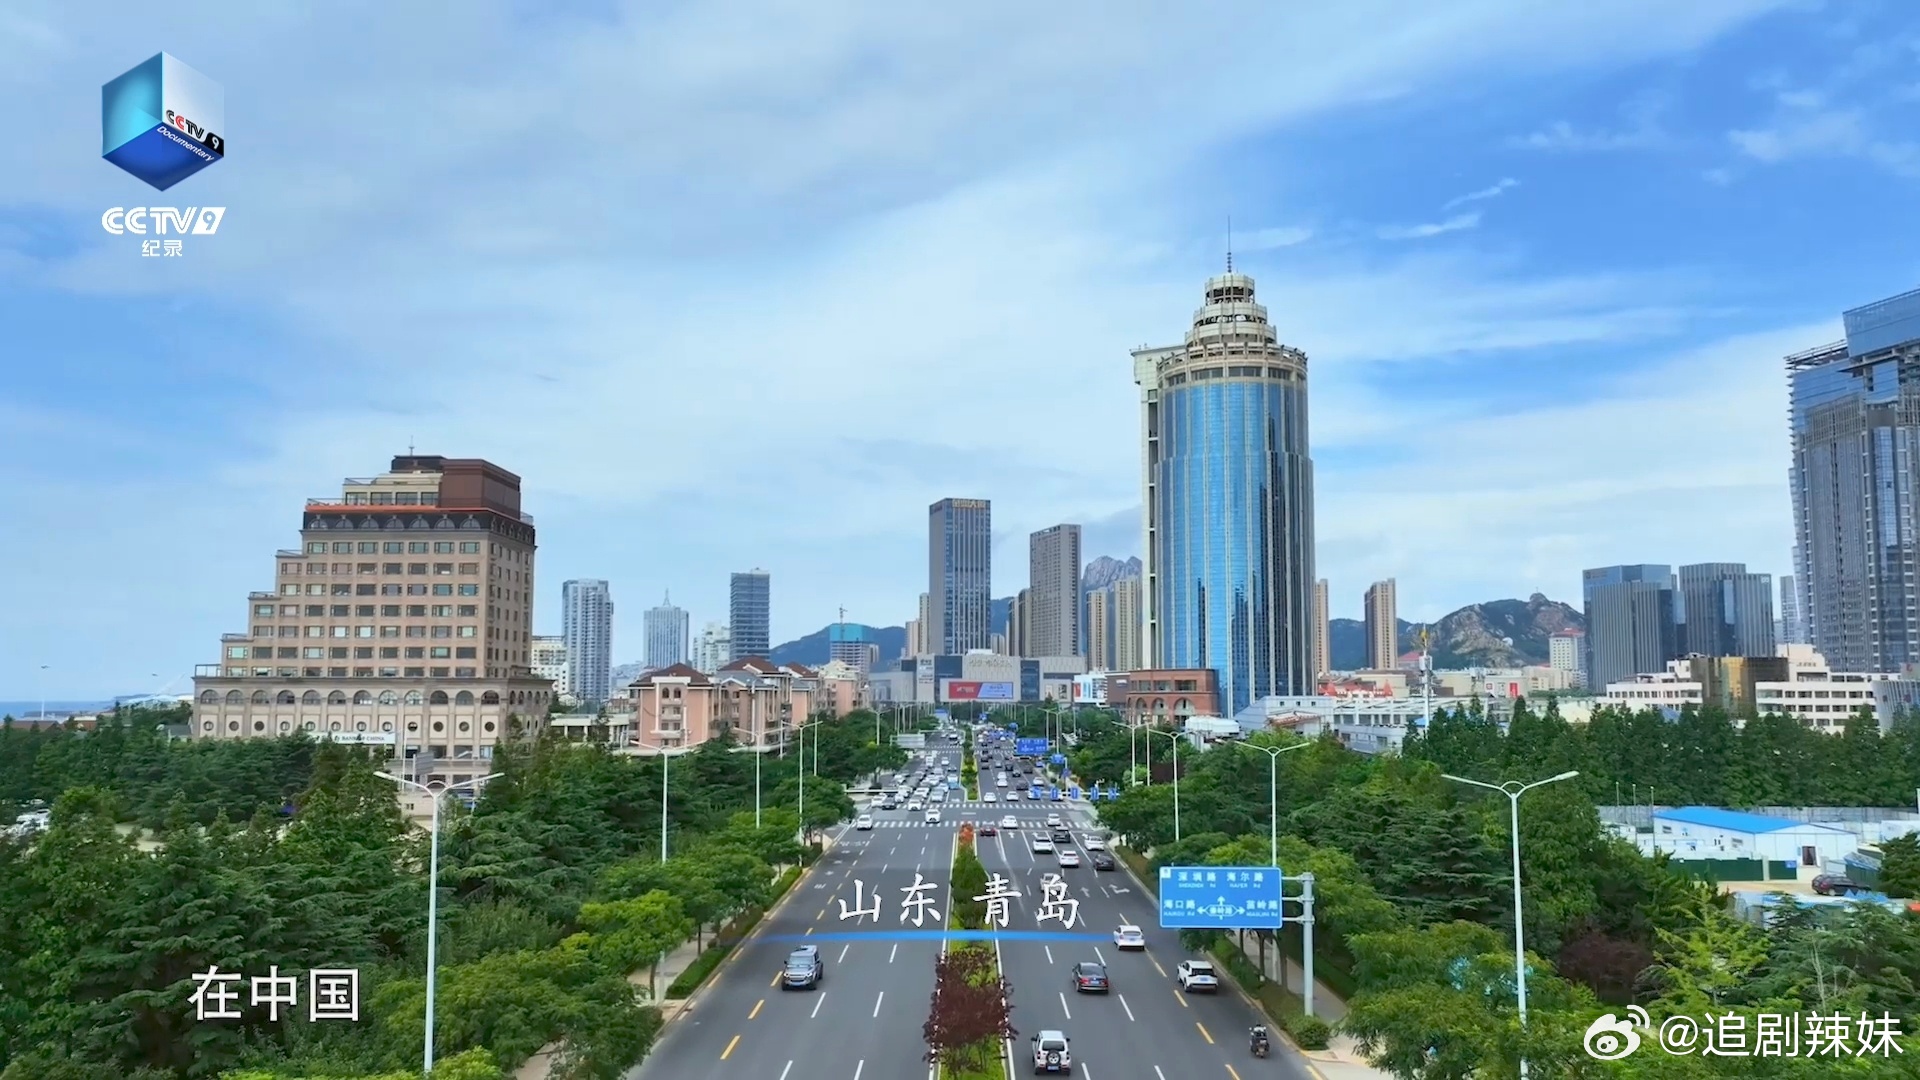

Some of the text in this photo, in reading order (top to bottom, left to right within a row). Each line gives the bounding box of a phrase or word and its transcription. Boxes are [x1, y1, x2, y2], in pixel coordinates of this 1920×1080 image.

[1178, 871, 1263, 881] 深圳路 海尔路
[1163, 900, 1195, 909] 海口路
[1246, 900, 1278, 909] 苗岭路
